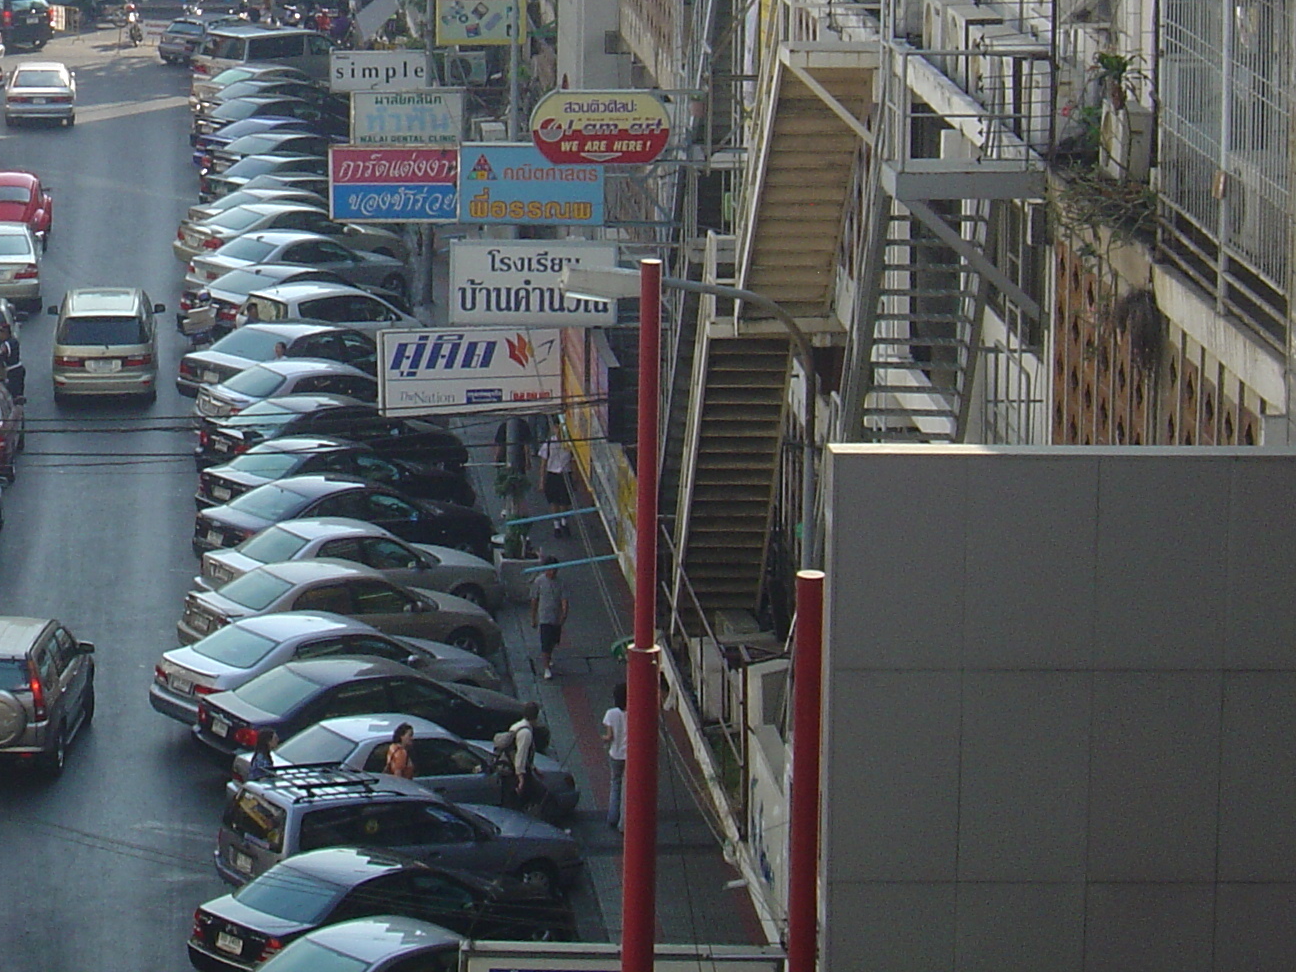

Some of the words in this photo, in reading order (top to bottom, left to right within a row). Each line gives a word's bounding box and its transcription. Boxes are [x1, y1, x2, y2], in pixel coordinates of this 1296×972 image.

[335, 60, 425, 84] simple
[561, 140, 580, 152] WE
[584, 140, 607, 152] ARE
